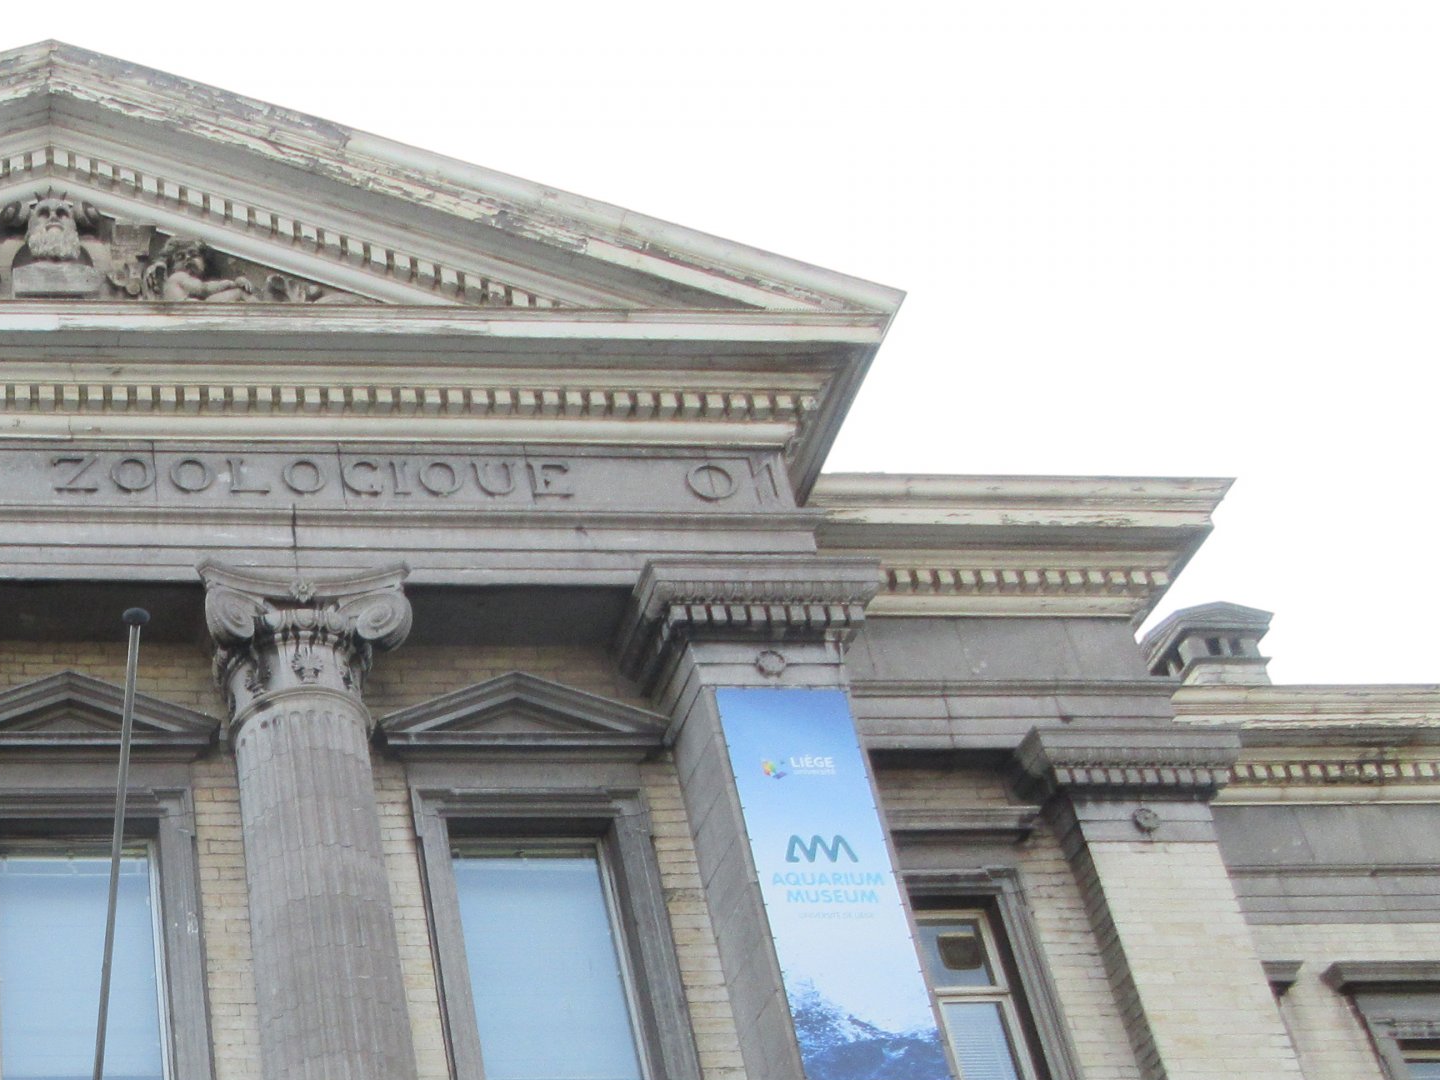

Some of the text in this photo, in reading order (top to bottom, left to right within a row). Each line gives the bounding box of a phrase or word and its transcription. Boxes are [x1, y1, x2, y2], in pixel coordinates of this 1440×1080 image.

[51, 457, 575, 497] ZOOLOGIQUE
[772, 872, 885, 886] AQUARIUM
[786, 889, 879, 903] MUSEUM
